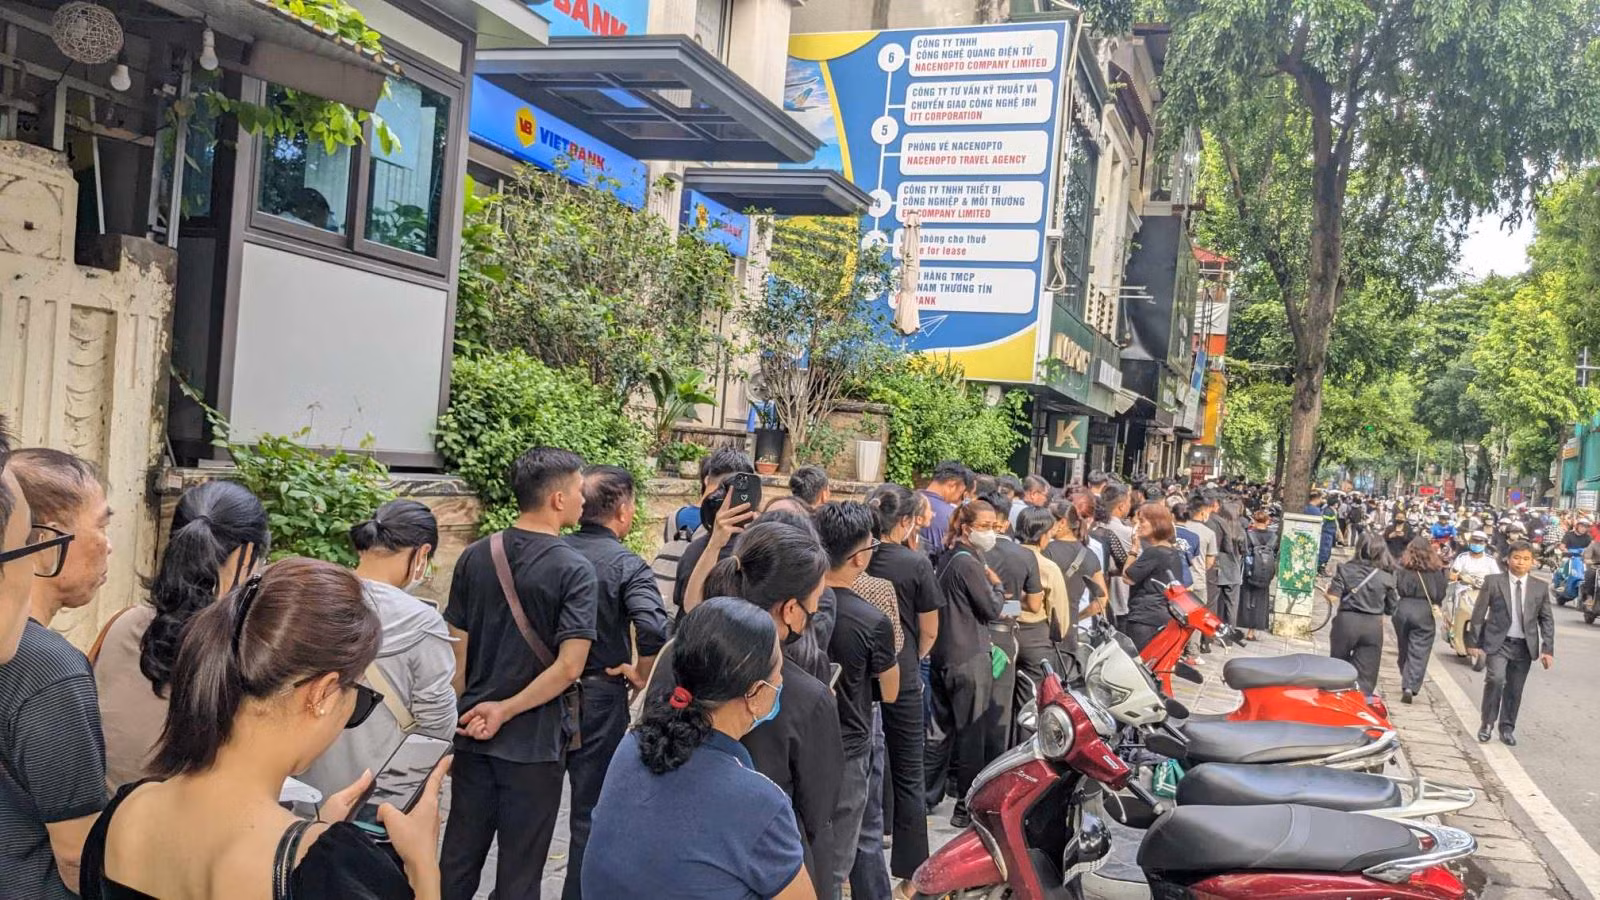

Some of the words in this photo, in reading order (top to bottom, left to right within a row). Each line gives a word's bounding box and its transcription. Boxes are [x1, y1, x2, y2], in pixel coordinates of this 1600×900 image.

[917, 37, 940, 49] CÔNG
[943, 38, 953, 48] TY
[955, 37, 978, 47] TNHH
[888, 52, 895, 63] 6
[916, 50, 939, 60] CÔNG
[941, 48, 964, 61] NGHỆ
[967, 48, 996, 59] QUANG
[914, 61, 965, 72] NACENOPTO
[967, 59, 1010, 71] COMPANY
[1012, 58, 1048, 69] LIMITED
[912, 86, 935, 97] CÔNG
[938, 87, 948, 96] TY
[946, 99, 967, 109] GIAO
[969, 97, 993, 109] CÔNG
[995, 97, 1019, 110] NGHỆ
[924, 110, 983, 121] CORPORATION
[881, 125, 888, 136] 5
[908, 140, 936, 151] PHÒNG
[951, 141, 1003, 151] NACENOPTO
[907, 155, 957, 165] NACENOPTO
[959, 155, 990, 165] TRAVEL
[992, 154, 1027, 164] AGENCY
[903, 184, 926, 195] CÔNG
[929, 185, 939, 194] TY
[941, 185, 963, 194] TNHH
[966, 182, 990, 194] THIẾT
[902, 196, 925, 206] CÔNG
[928, 196, 959, 208] NGHIỆP
[961, 197, 968, 206] &
[971, 196, 988, 206] MÔI
[918, 208, 957, 218] COMPANY
[958, 208, 991, 218] LIMITED
[948, 234, 964, 244] cho
[966, 234, 987, 244] thuê
[927, 246, 939, 256] for
[942, 246, 967, 256] lease
[923, 269, 948, 281] HÀNG
[950, 272, 975, 282] TMCP
[940, 283, 975, 294] THƯƠNG
[978, 282, 993, 294] TÍN
[1055, 419, 1081, 449] K
